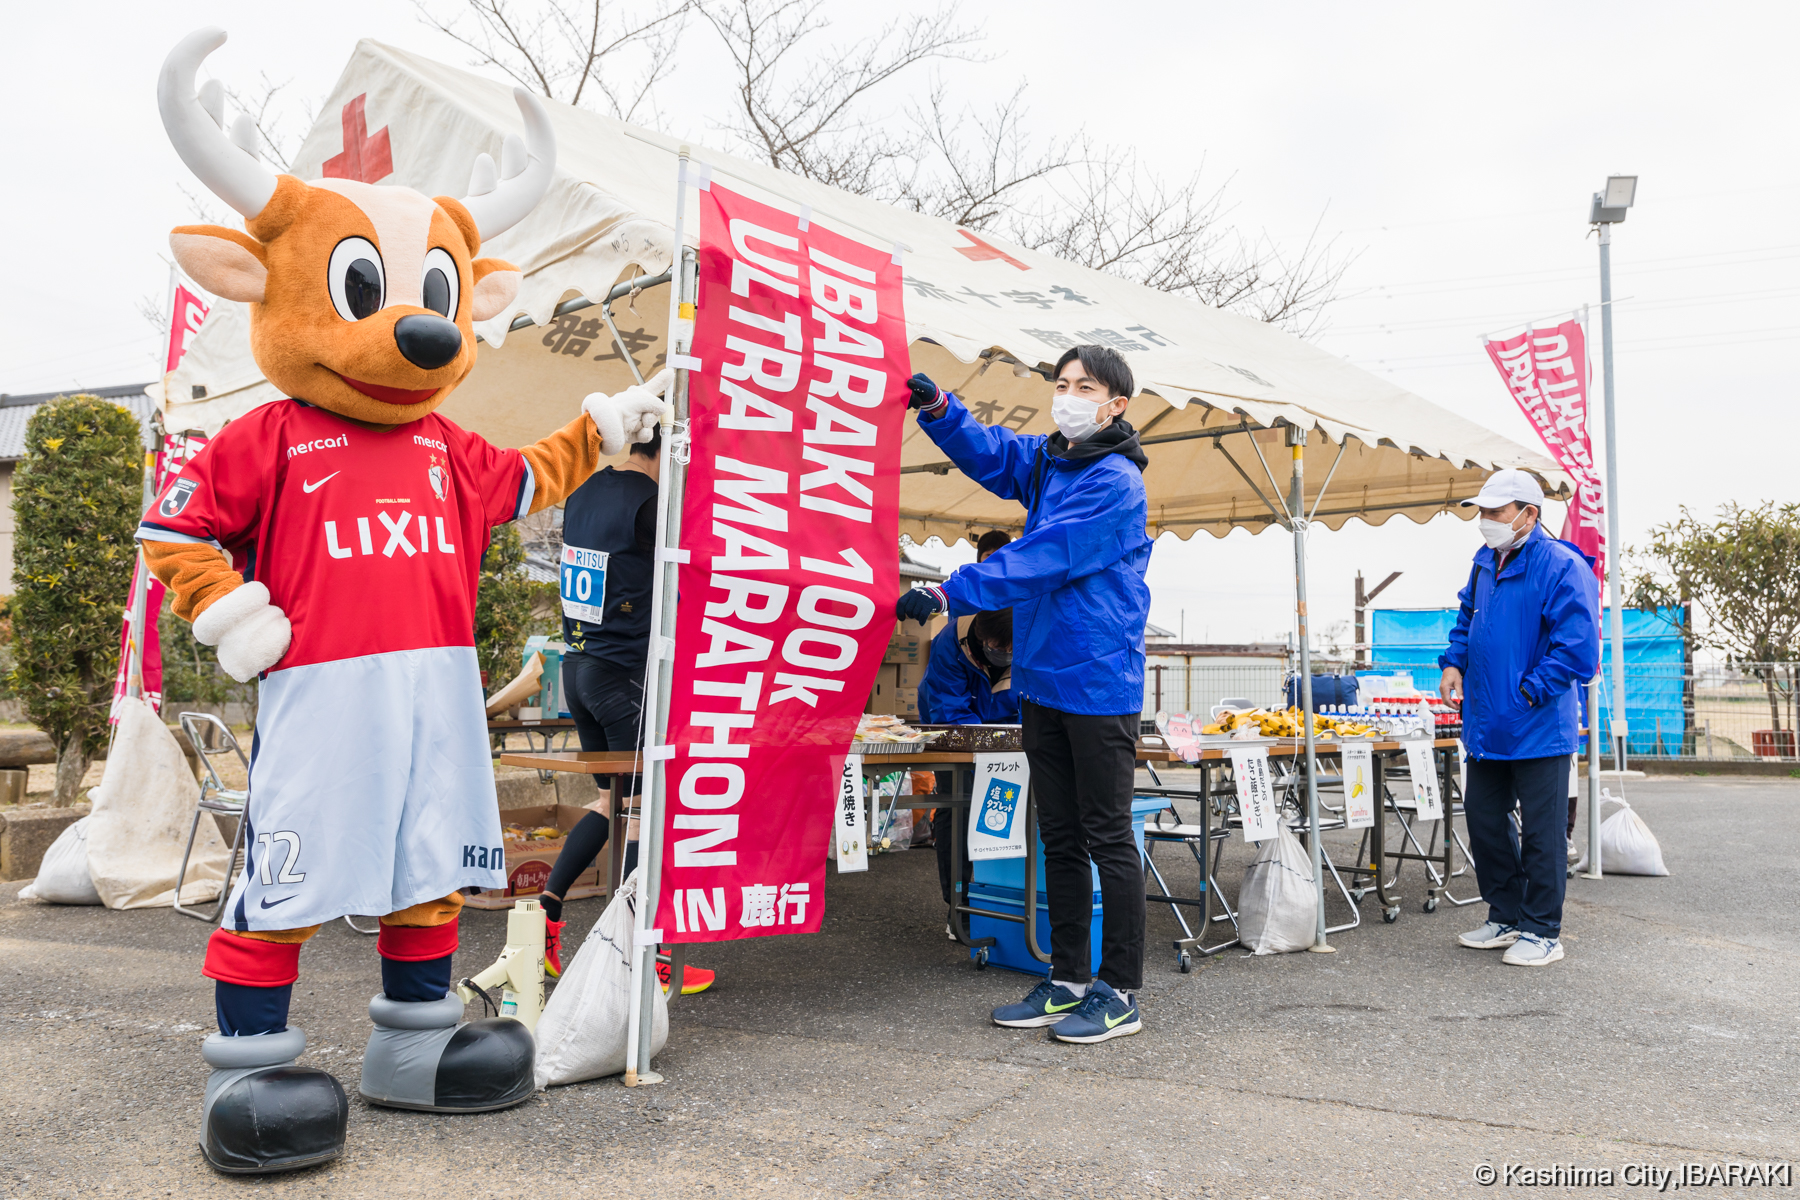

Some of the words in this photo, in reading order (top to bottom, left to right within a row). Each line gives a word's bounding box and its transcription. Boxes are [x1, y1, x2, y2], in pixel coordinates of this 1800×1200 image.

[718, 218, 802, 432] ULTRA
[800, 246, 887, 523] IBARAKI
[287, 433, 349, 460] mercari
[324, 510, 455, 559] LIXIL
[565, 568, 592, 601] 10
[576, 551, 605, 569] RITSU
[673, 455, 789, 867] MARATHON
[987, 762, 1020, 773] タブレット
[842, 763, 855, 827] どら焼き
[987, 799, 1013, 812] タブレット
[990, 785, 1001, 800] 塩
[258, 830, 306, 885] 12
[672, 887, 727, 933] IN
[739, 883, 810, 928] 鹿行
